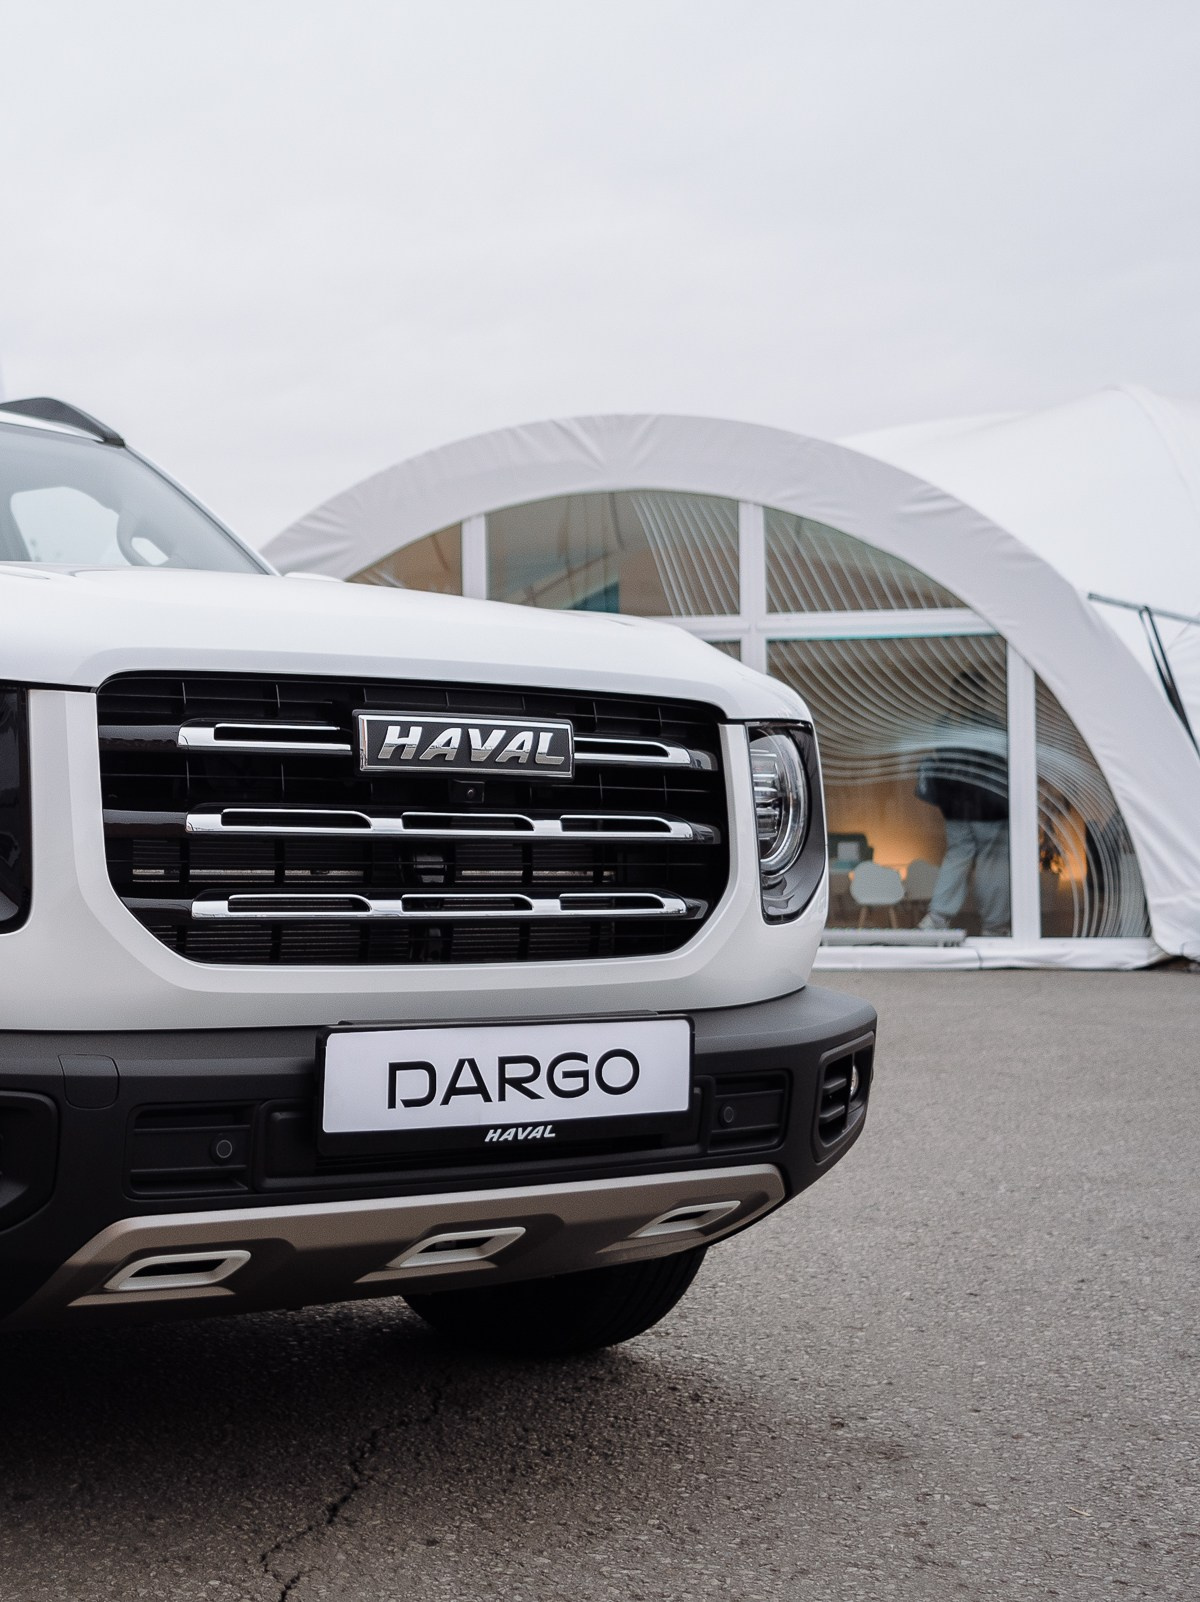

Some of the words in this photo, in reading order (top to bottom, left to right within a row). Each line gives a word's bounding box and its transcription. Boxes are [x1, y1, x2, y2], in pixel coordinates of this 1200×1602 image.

[377, 725, 565, 765] HAVAL
[387, 1048, 640, 1109] DARGO
[484, 1124, 556, 1143] HAVAL
